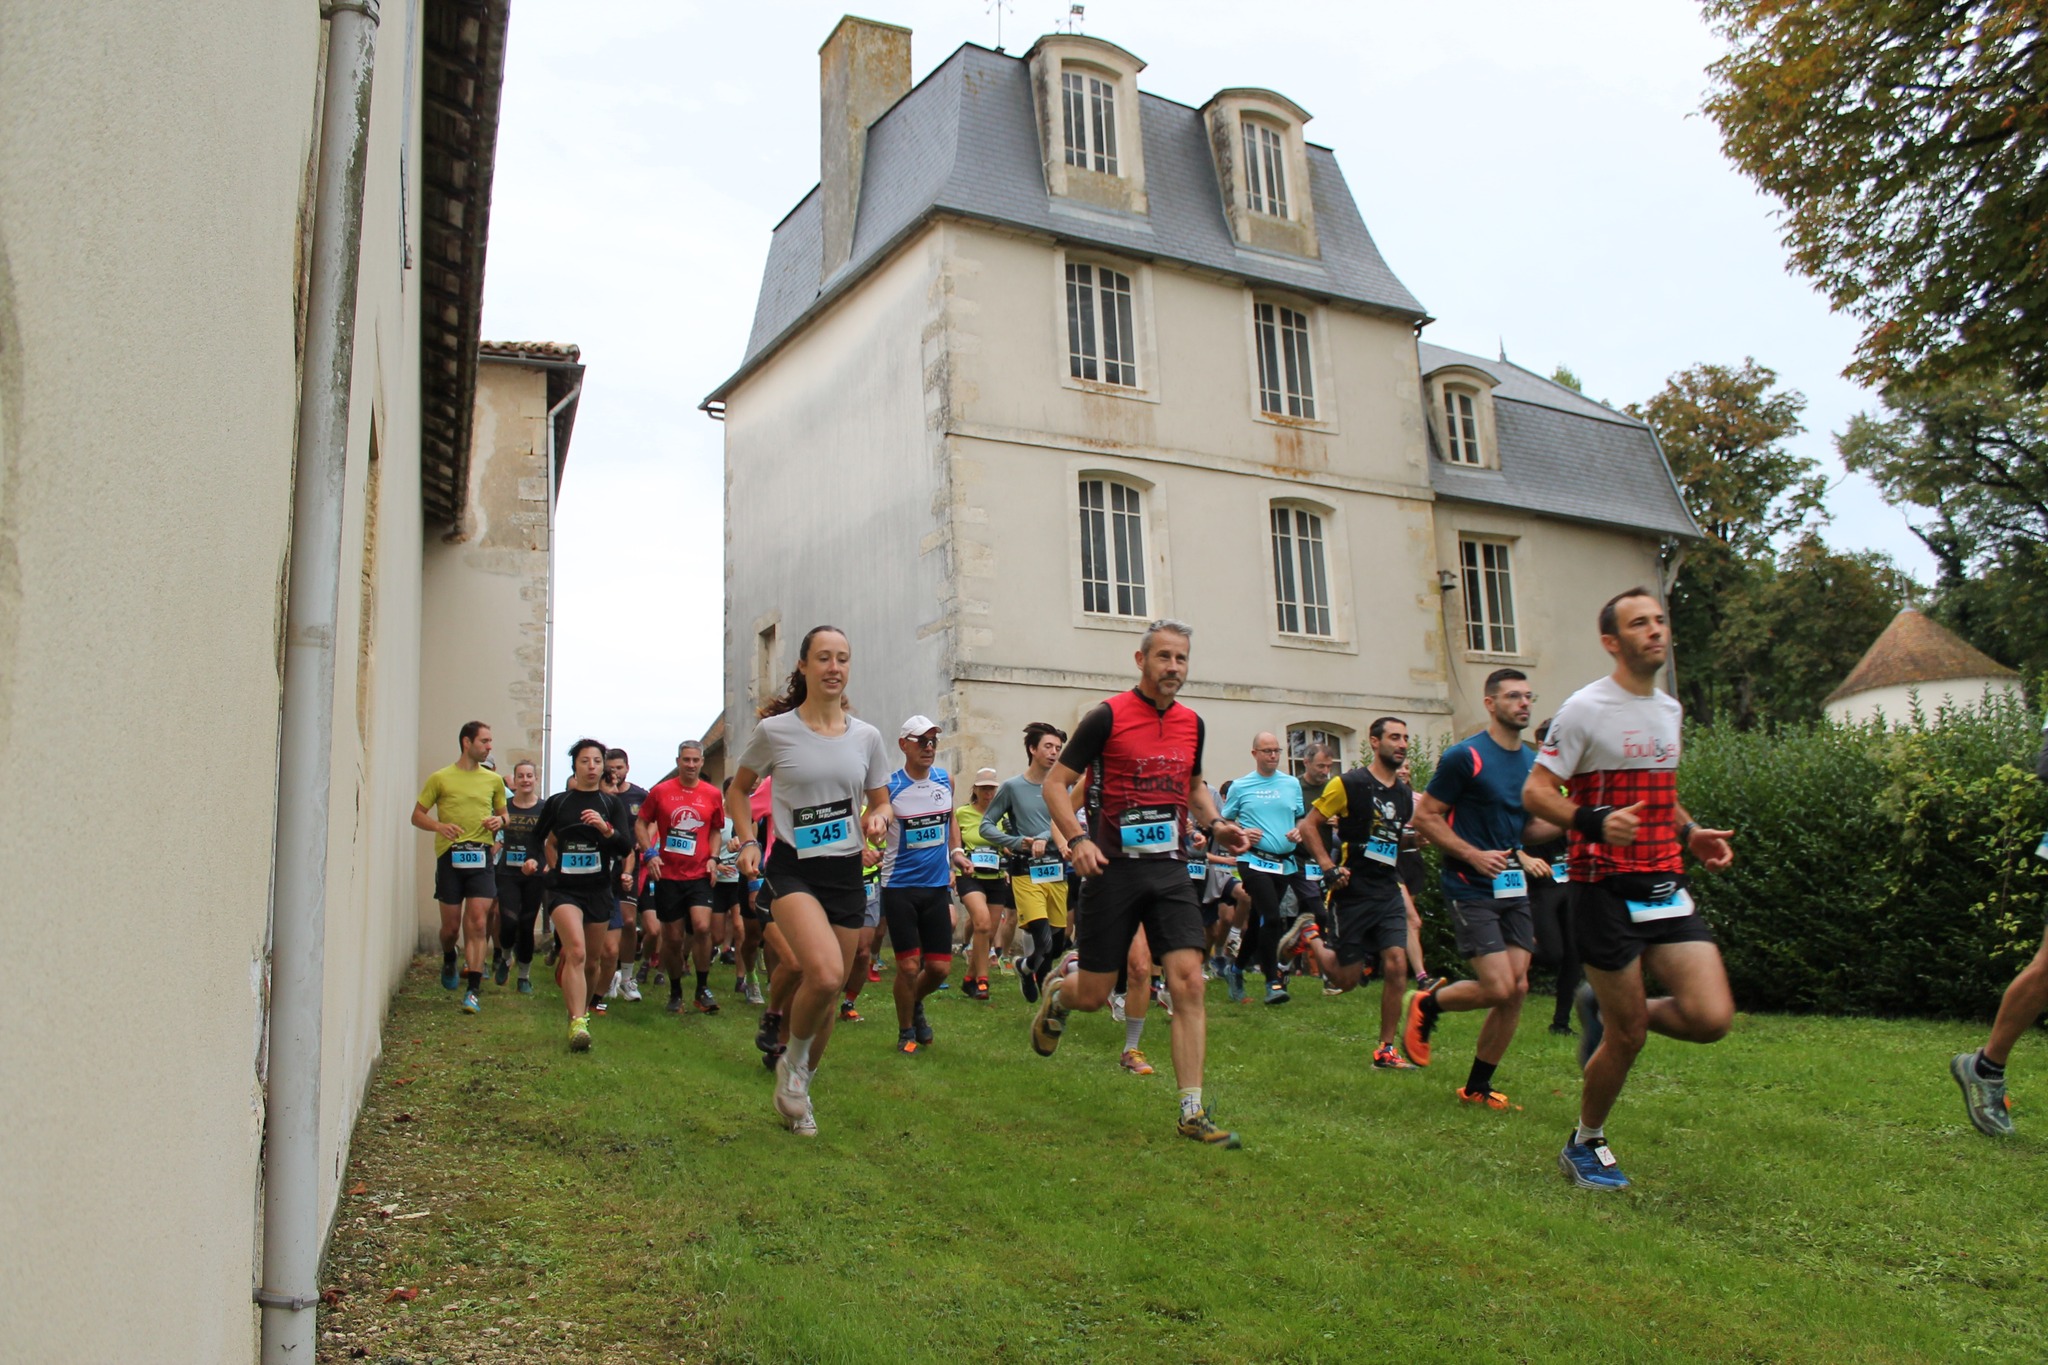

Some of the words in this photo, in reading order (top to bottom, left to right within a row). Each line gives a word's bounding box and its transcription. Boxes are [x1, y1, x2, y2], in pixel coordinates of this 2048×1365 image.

[816, 807, 832, 815] TERRE
[810, 823, 841, 844] 345
[916, 828, 936, 841] 348
[1135, 826, 1165, 843] 346
[671, 838, 688, 849] 360
[460, 853, 478, 862] 303
[571, 856, 592, 866] 312
[978, 855, 994, 863] 324
[1257, 859, 1274, 869] 372
[1037, 866, 1055, 876] 342
[1504, 873, 1521, 887] 302
